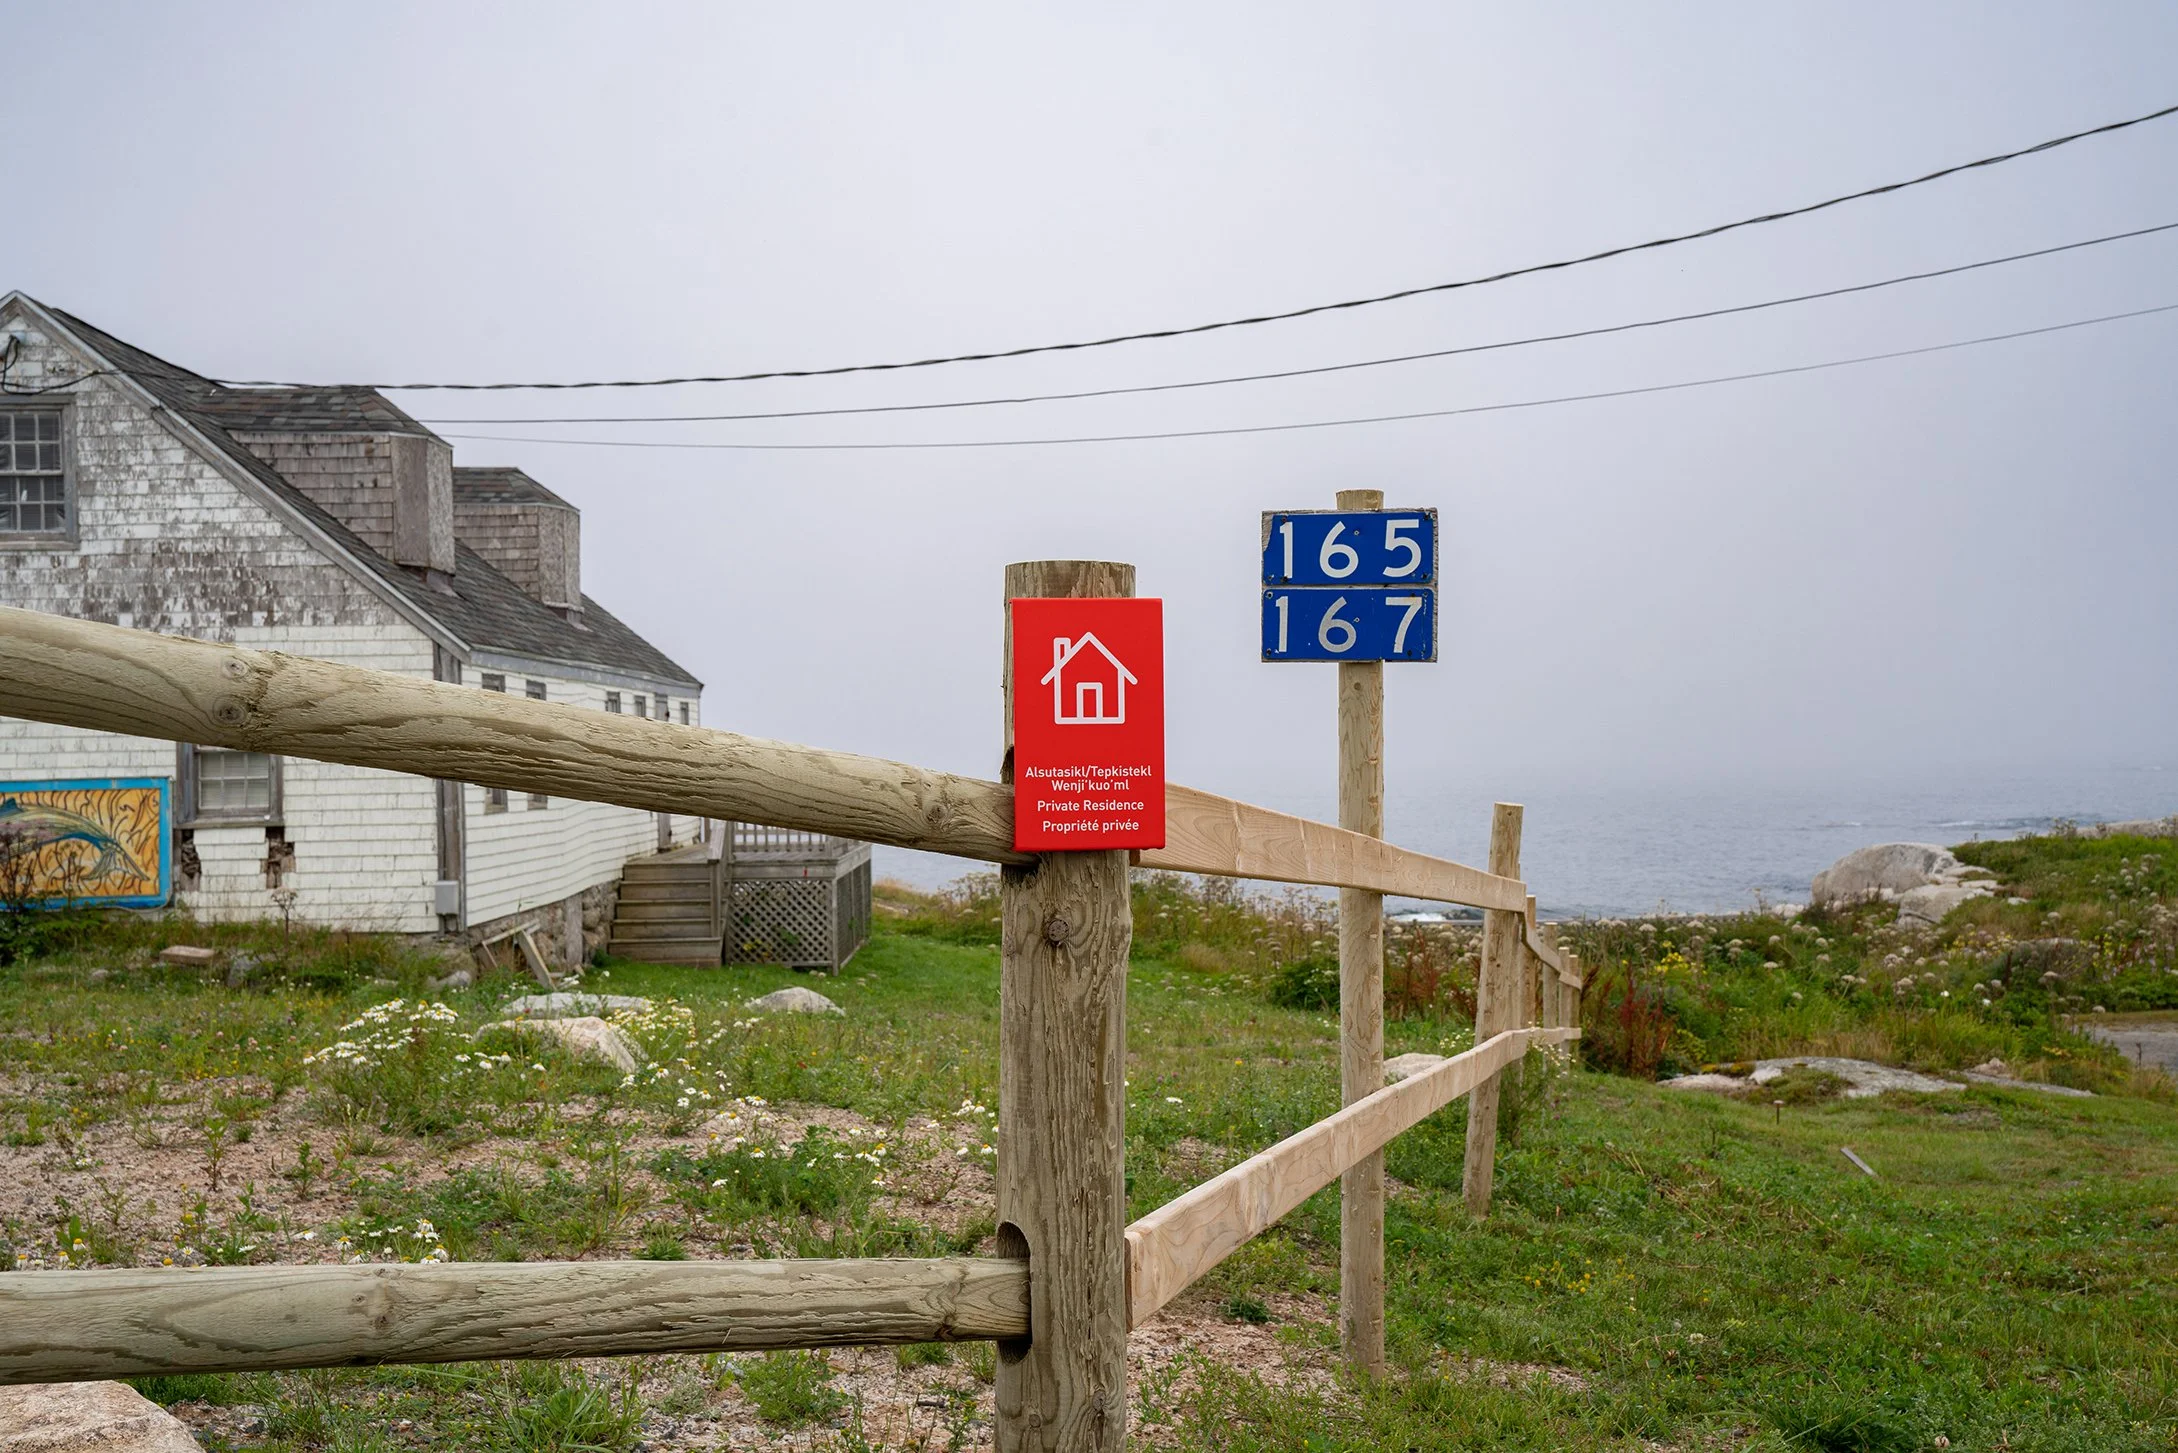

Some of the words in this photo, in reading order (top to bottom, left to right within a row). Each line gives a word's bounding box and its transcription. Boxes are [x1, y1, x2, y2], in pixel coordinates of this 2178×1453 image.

[1279, 518, 1422, 579] 165
[1275, 596, 1423, 654] 167
[1025, 765, 1152, 779] Alsutasikl/Tepkistekl
[1037, 800, 1080, 812] Private
[1083, 799, 1144, 811] Residence
[1042, 819, 1099, 834] Propriété
[1102, 818, 1139, 833] privée
